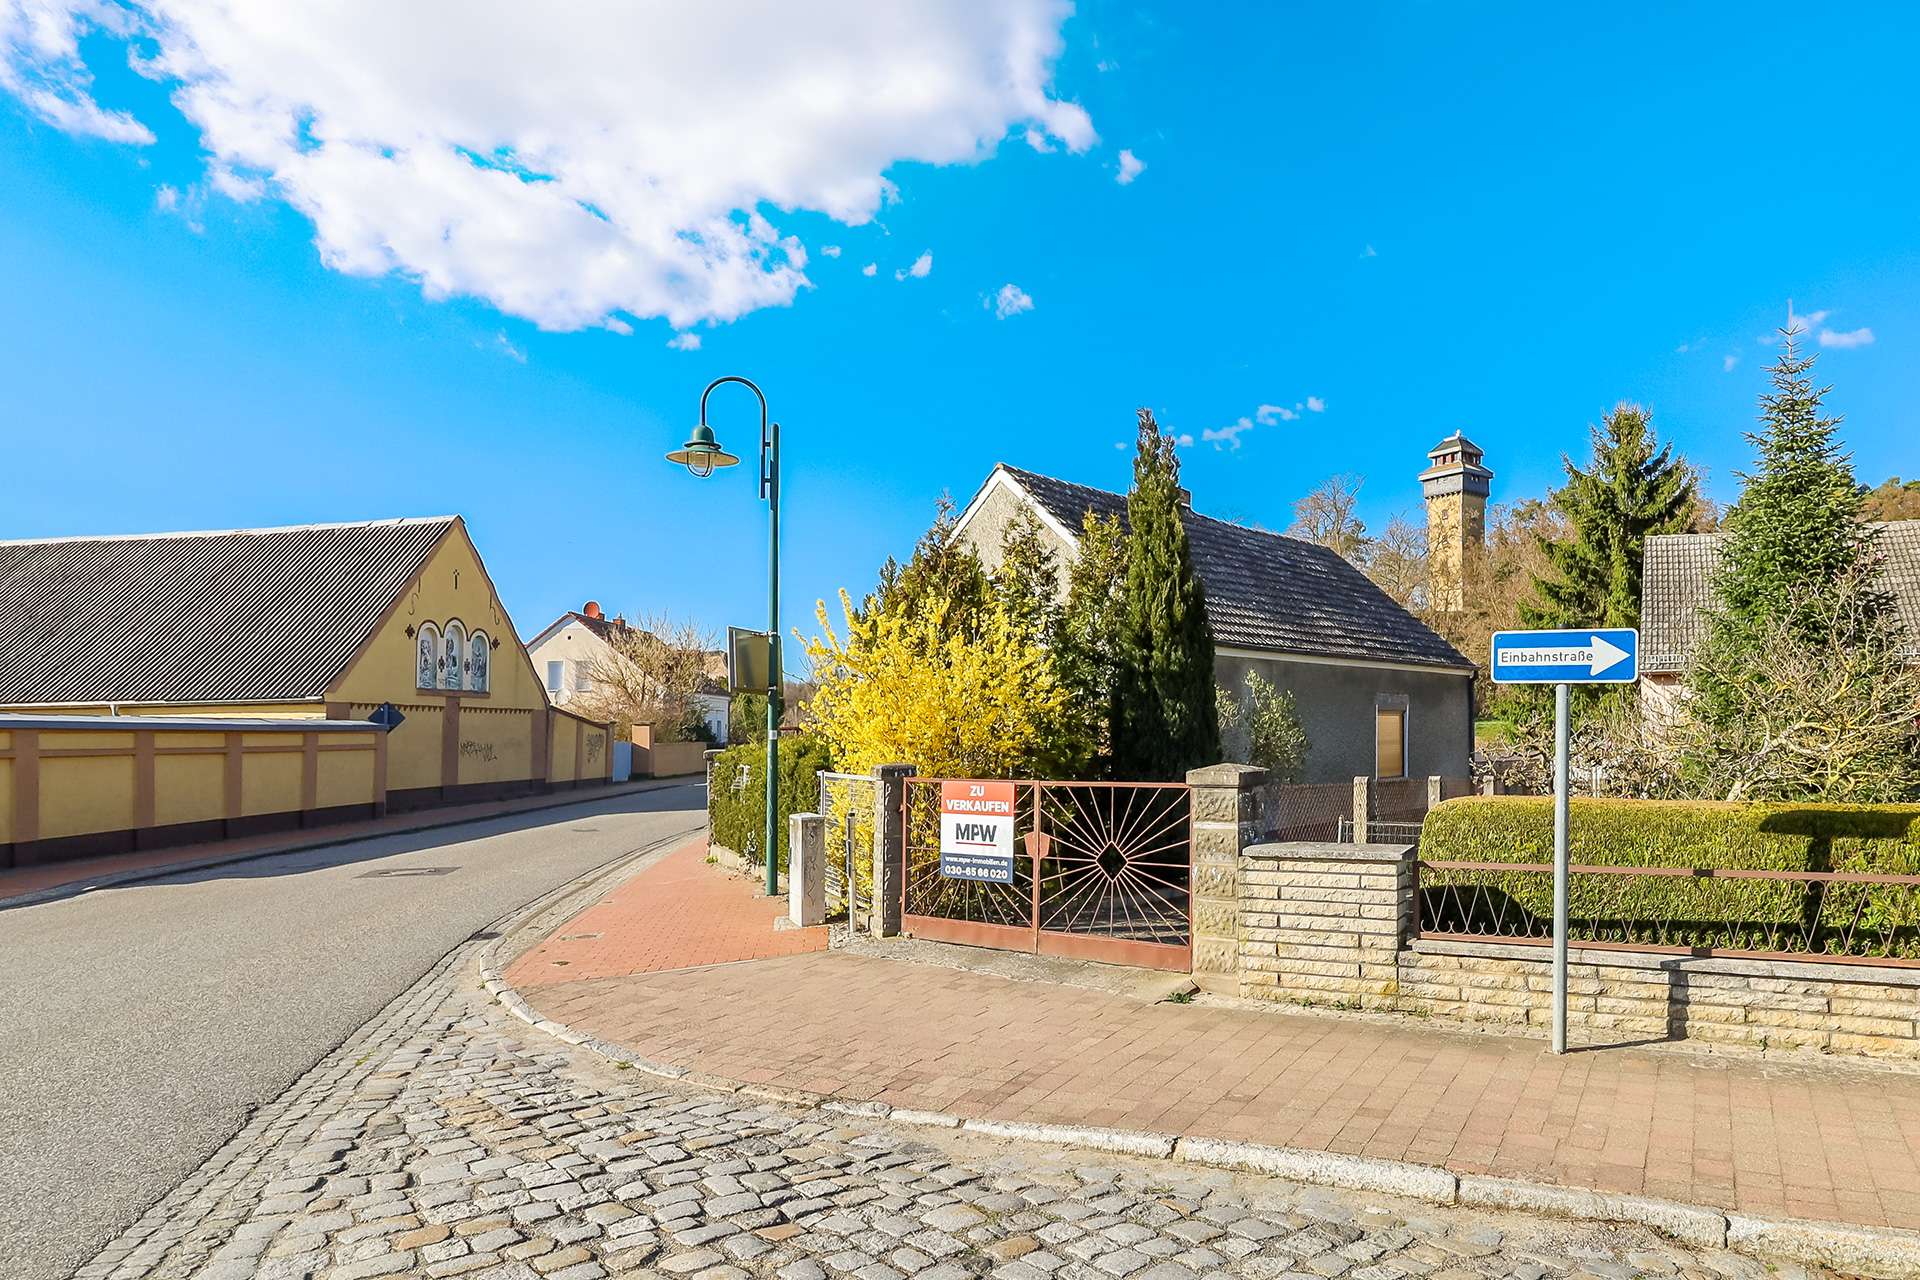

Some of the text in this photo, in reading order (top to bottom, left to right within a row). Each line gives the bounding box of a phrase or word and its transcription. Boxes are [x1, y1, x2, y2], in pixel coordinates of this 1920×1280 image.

[1501, 651, 1593, 663] Einbahnstraße
[969, 785, 985, 797] ZU
[946, 799, 1009, 812] VERKAUFEN
[955, 822, 997, 842] MPW
[945, 865, 1008, 879] 030-65 66 020
